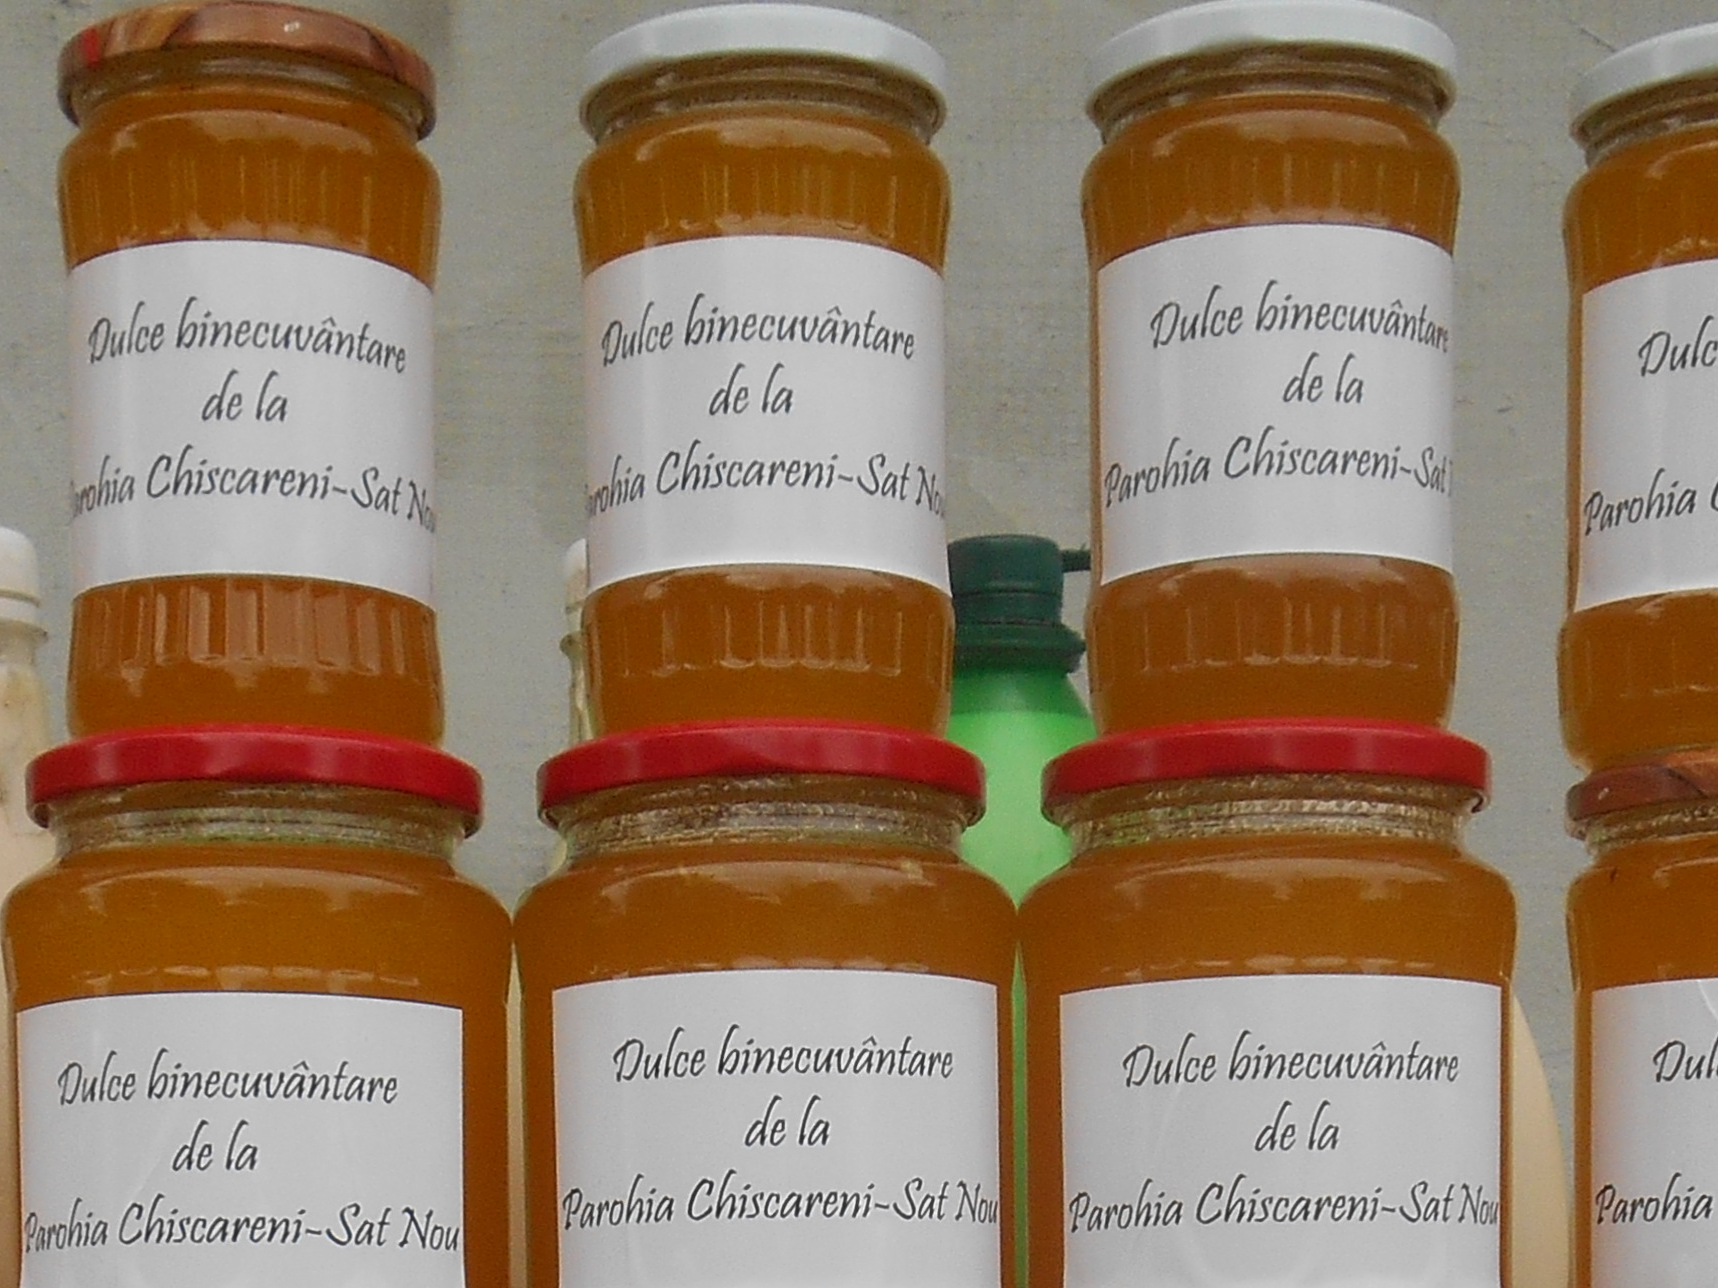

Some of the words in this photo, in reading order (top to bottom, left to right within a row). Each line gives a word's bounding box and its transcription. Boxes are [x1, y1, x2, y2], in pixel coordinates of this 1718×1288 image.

[89, 301, 164, 363] Dulce
[177, 297, 406, 374] binecuvântare
[602, 302, 673, 366] Dulce
[684, 293, 914, 359] binecuvântare
[1150, 285, 1243, 348] Dulce
[202, 370, 243, 422] de
[256, 371, 288, 422] la
[709, 363, 749, 416] de
[762, 362, 793, 414] la
[1283, 352, 1323, 403] de
[1335, 353, 1364, 404] la
[147, 445, 401, 515] Chiscareni-Sat
[656, 439, 909, 500] Chiscareni-Sat
[1105, 437, 1209, 509] Parohia
[1585, 468, 1696, 535] Parohia
[58, 1051, 136, 1105] Dulce
[147, 1048, 398, 1104] binecuvântare
[612, 1027, 706, 1083] Dulce
[718, 1024, 953, 1079] binecuvântare
[1123, 1033, 1216, 1087] Dulce
[1228, 1030, 1459, 1084] binecuvântare
[172, 1120, 212, 1172] de
[225, 1120, 258, 1172] la
[745, 1095, 786, 1147] de
[798, 1095, 830, 1146] la
[1254, 1100, 1295, 1152] de
[1308, 1100, 1340, 1151] la
[25, 1197, 108, 1253] Parohia
[118, 1193, 391, 1247] Chiscareni-Sat
[398, 1206, 459, 1252] Nou
[563, 1174, 674, 1230] Parohia
[687, 1169, 950, 1222] Chiscareni-Sat
[954, 1180, 998, 1224] Nou
[1069, 1178, 1183, 1233] Parohia
[1196, 1174, 1454, 1224] Chiscareni-Sat
[1595, 1172, 1712, 1224] Parohia
